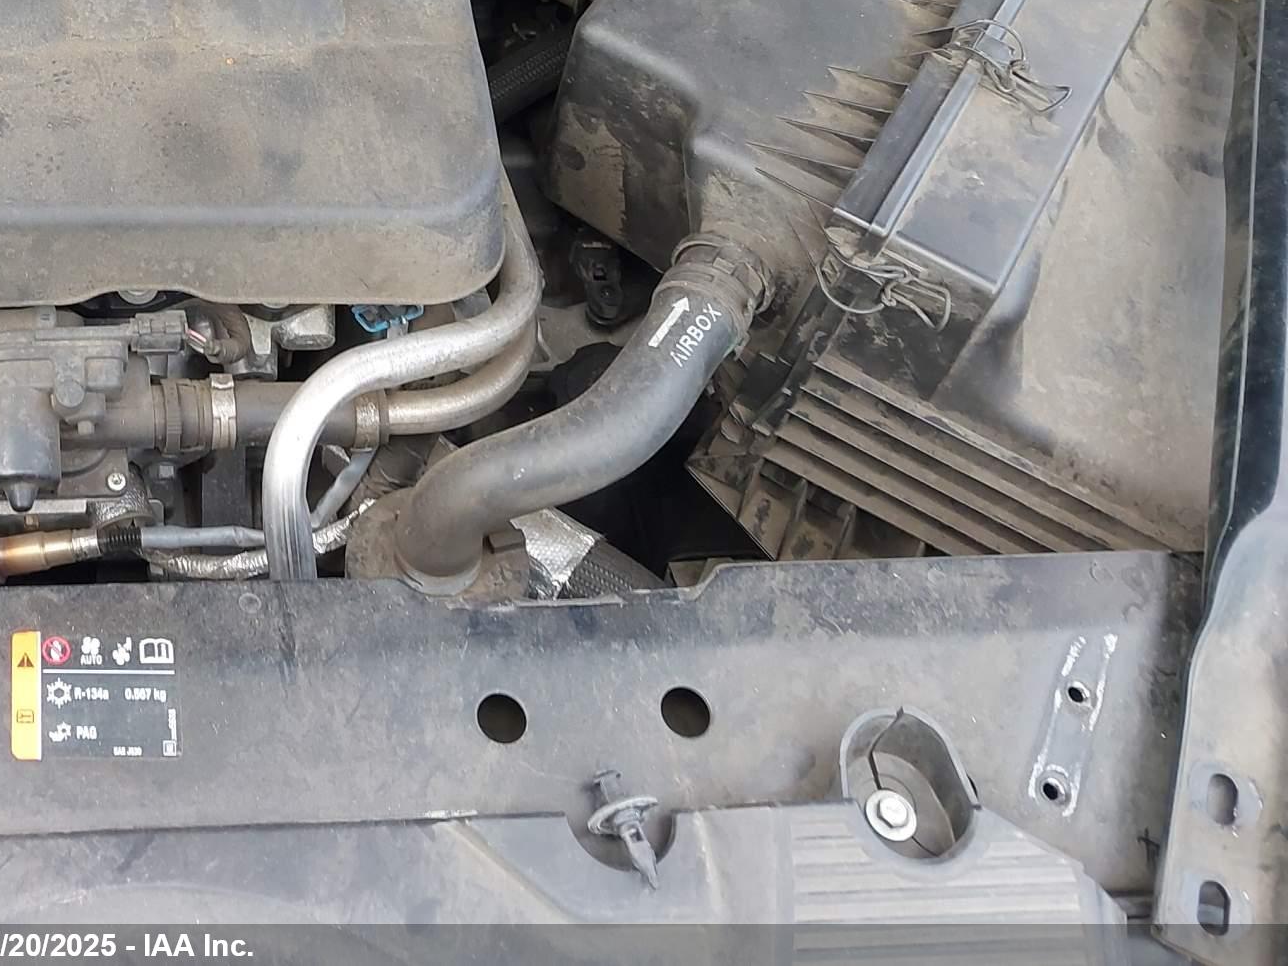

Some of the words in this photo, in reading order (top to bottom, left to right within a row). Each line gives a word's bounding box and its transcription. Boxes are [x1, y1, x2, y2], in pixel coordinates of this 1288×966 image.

[669, 302, 722, 368] AIRBOX
[80, 654, 103, 666] AUTO
[73, 687, 110, 701] R-134a
[153, 687, 167, 703] kg
[76, 725, 98, 740] PAG
